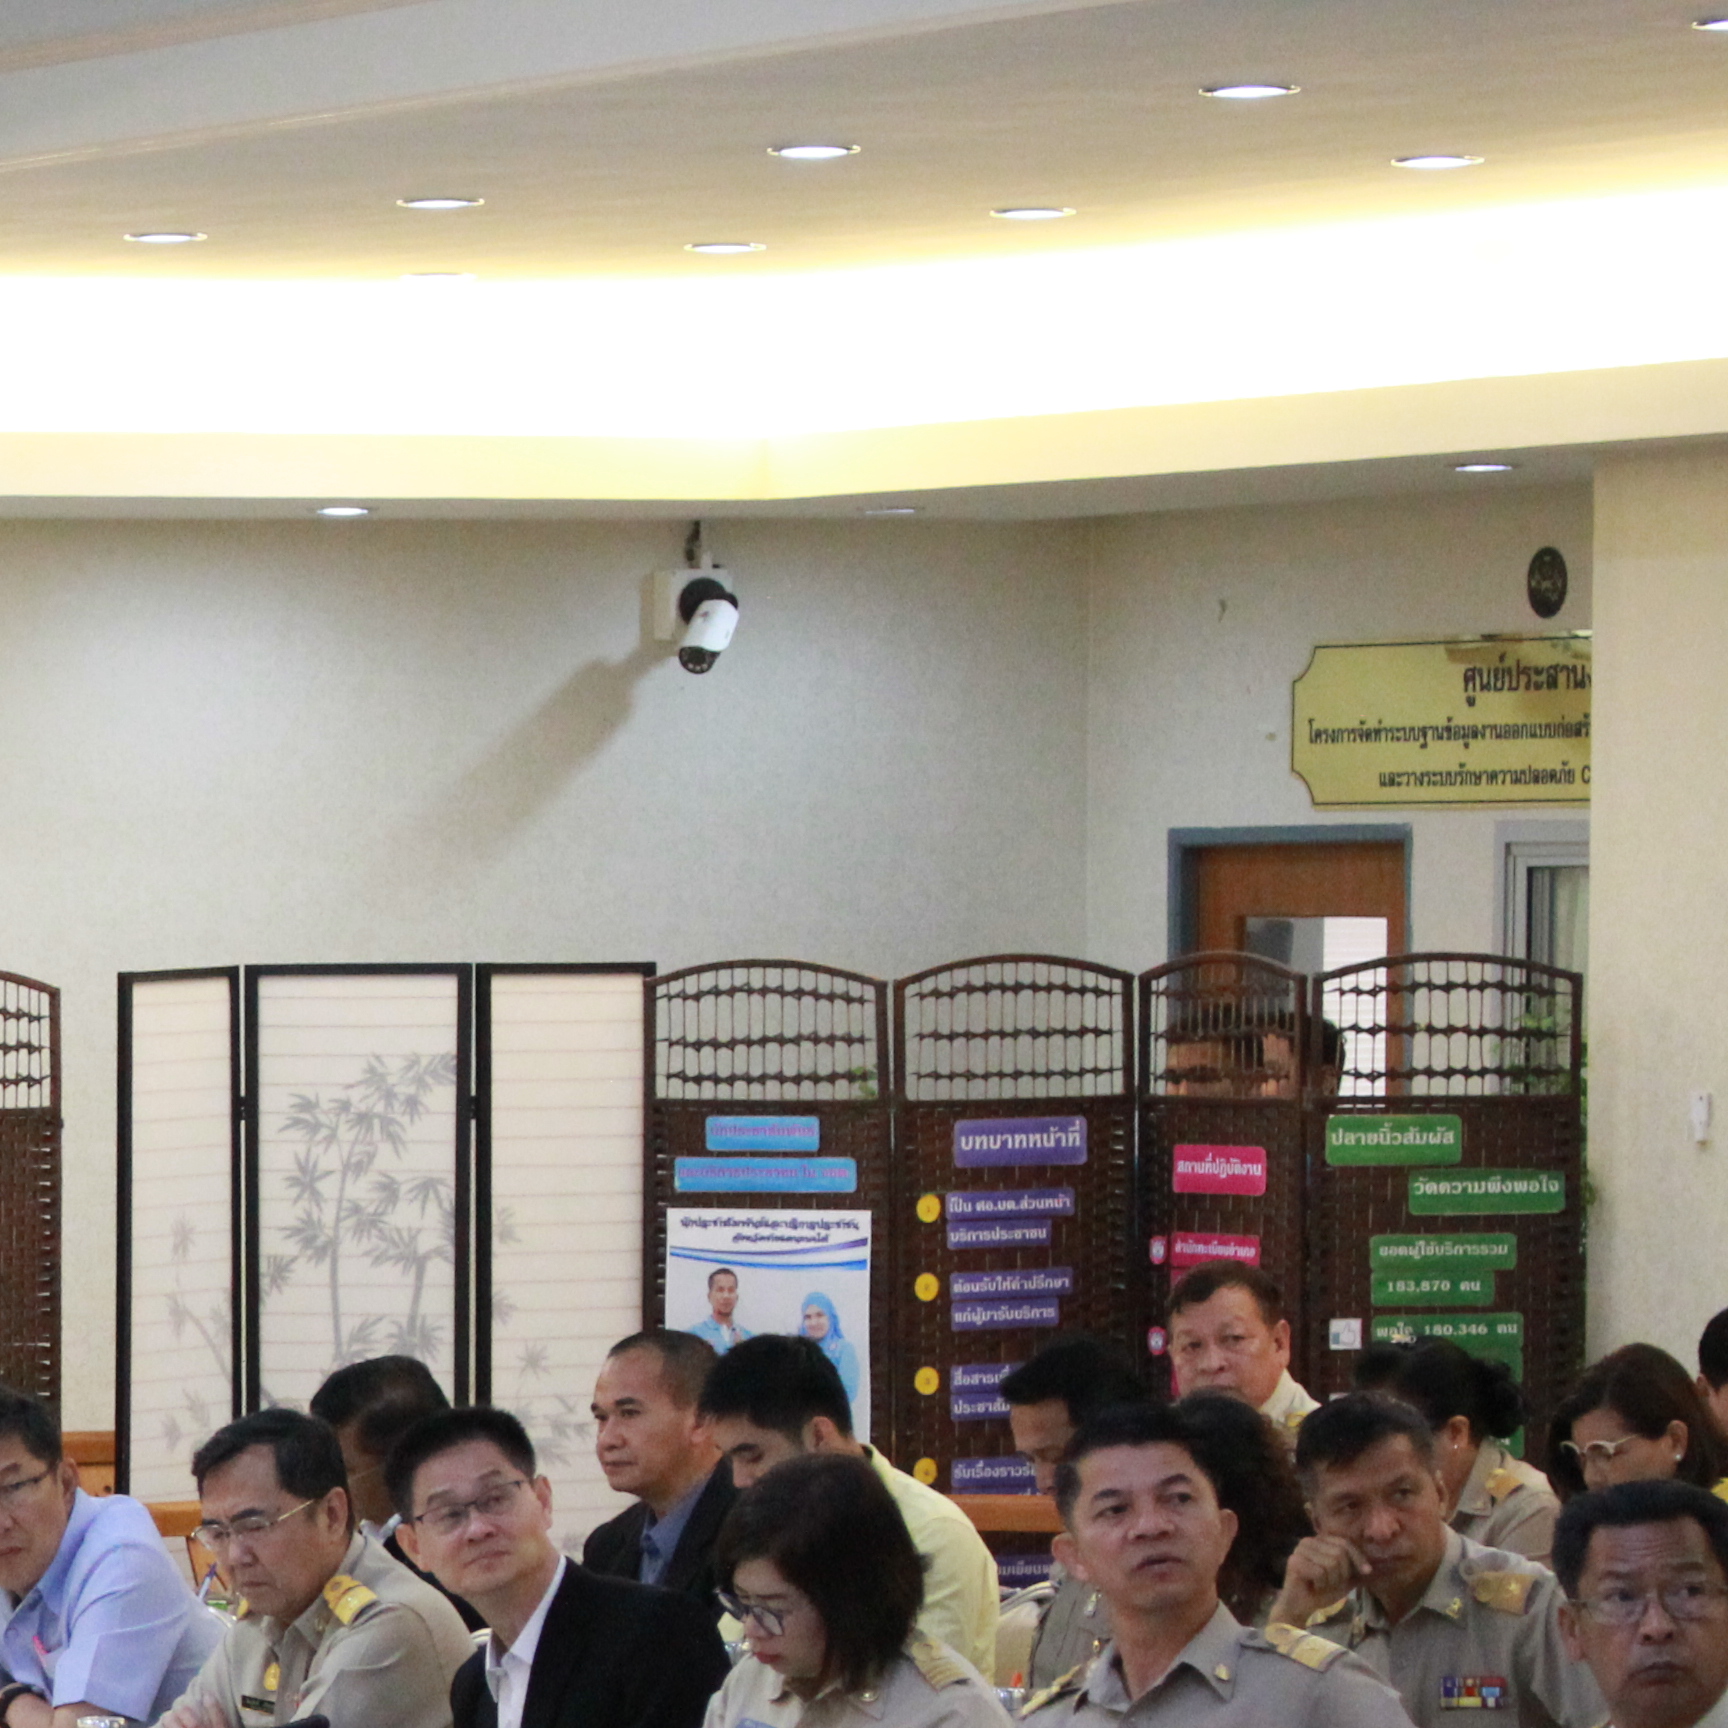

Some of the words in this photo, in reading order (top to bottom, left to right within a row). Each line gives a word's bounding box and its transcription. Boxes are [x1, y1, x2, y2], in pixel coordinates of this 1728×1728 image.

[960, 1121, 1081, 1151] บทบาทหน้าที่
[1331, 1122, 1455, 1146] ปลายนิ้วสัมผัส
[1177, 1152, 1262, 1178] สถานที่ปฏิบัติงาน
[1413, 1175, 1560, 1195] วัดความพึงพอใจ
[950, 1226, 1047, 1241] บริการประชาชน
[1379, 1239, 1508, 1260] ยอดผู้ใช้บริการรวม
[1459, 1280, 1481, 1292] คน
[954, 1304, 1056, 1325] แก่ผู้มารับบริการ
